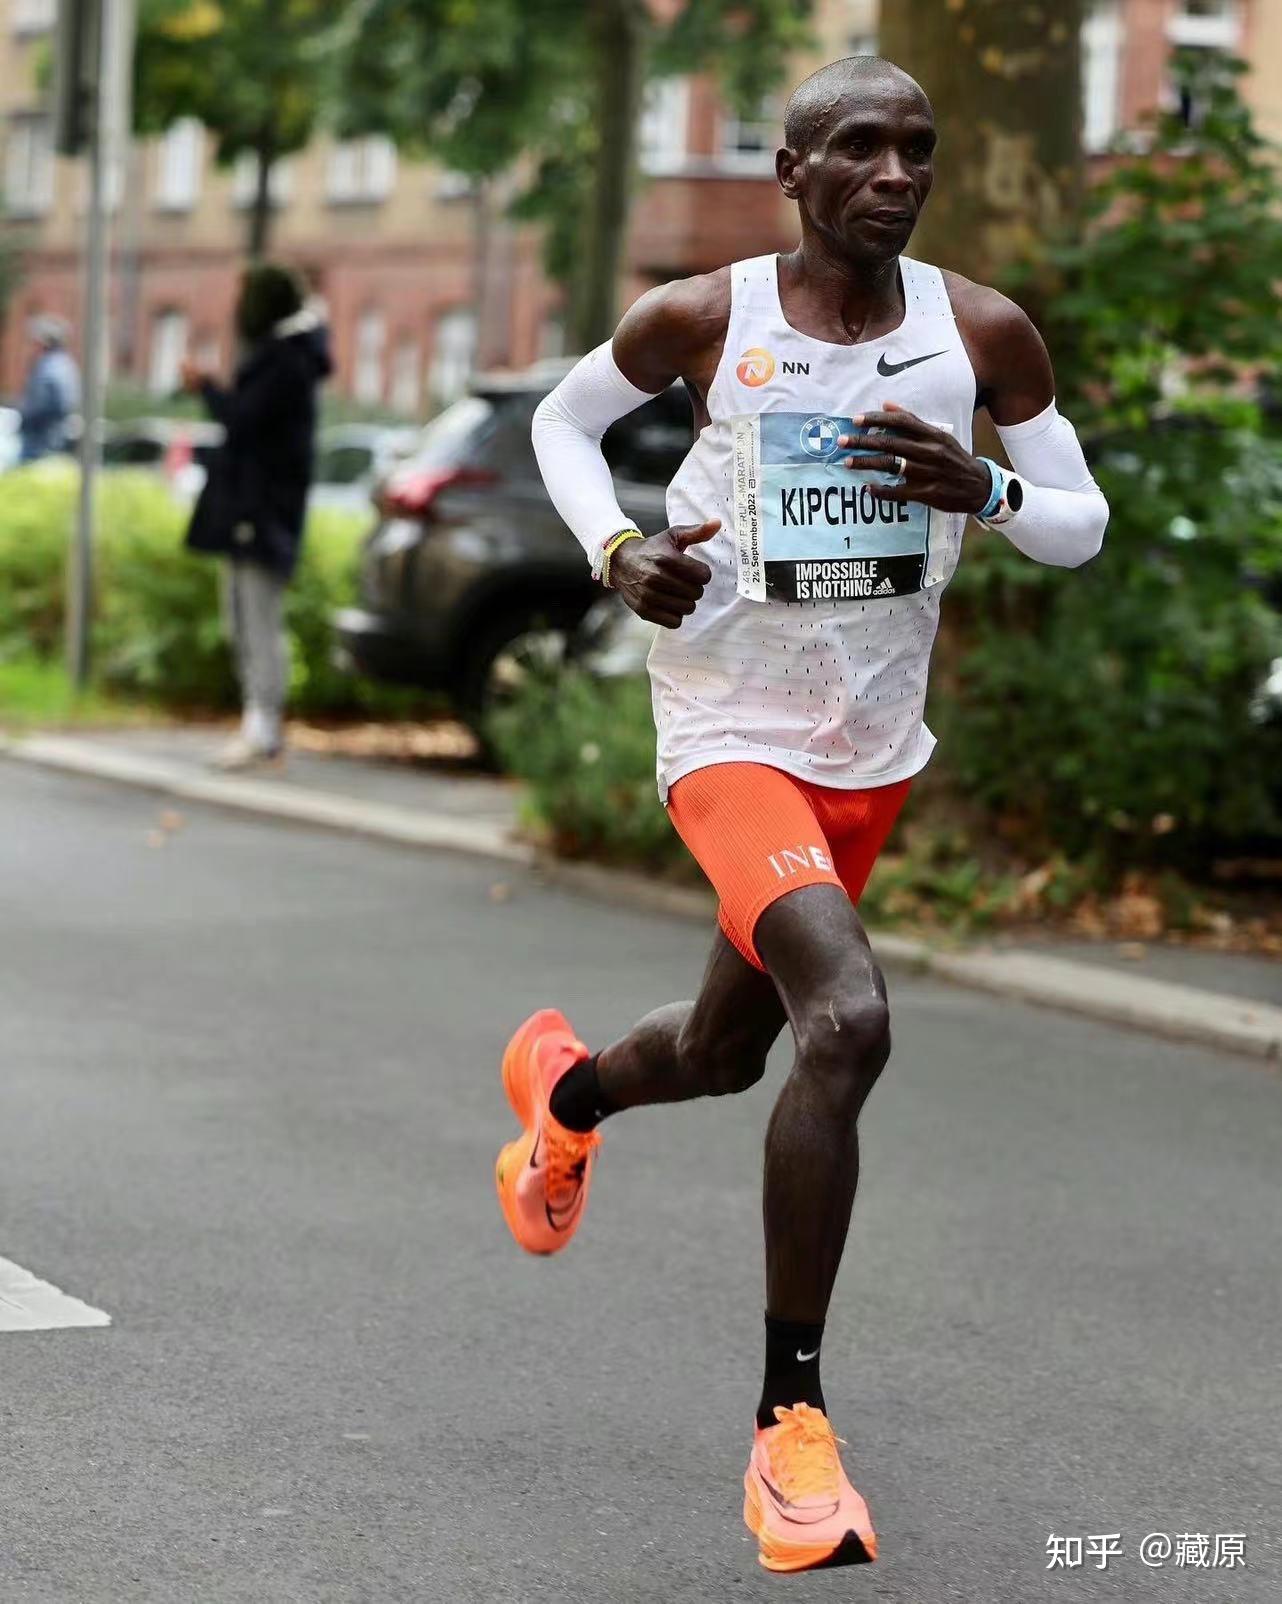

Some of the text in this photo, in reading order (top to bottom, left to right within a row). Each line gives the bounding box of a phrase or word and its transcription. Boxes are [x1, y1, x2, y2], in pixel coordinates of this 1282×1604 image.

[782, 361, 810, 375] NN
[748, 493, 757, 516] 2022
[781, 485, 909, 526] KIPCHOGE
[749, 517, 760, 568] September
[843, 536, 851, 550] 1
[742, 567, 751, 584] 48.
[795, 561, 878, 581] IMPOSSIBLE
[796, 579, 873, 599] IS NOTHING
[872, 587, 896, 595] adidas
